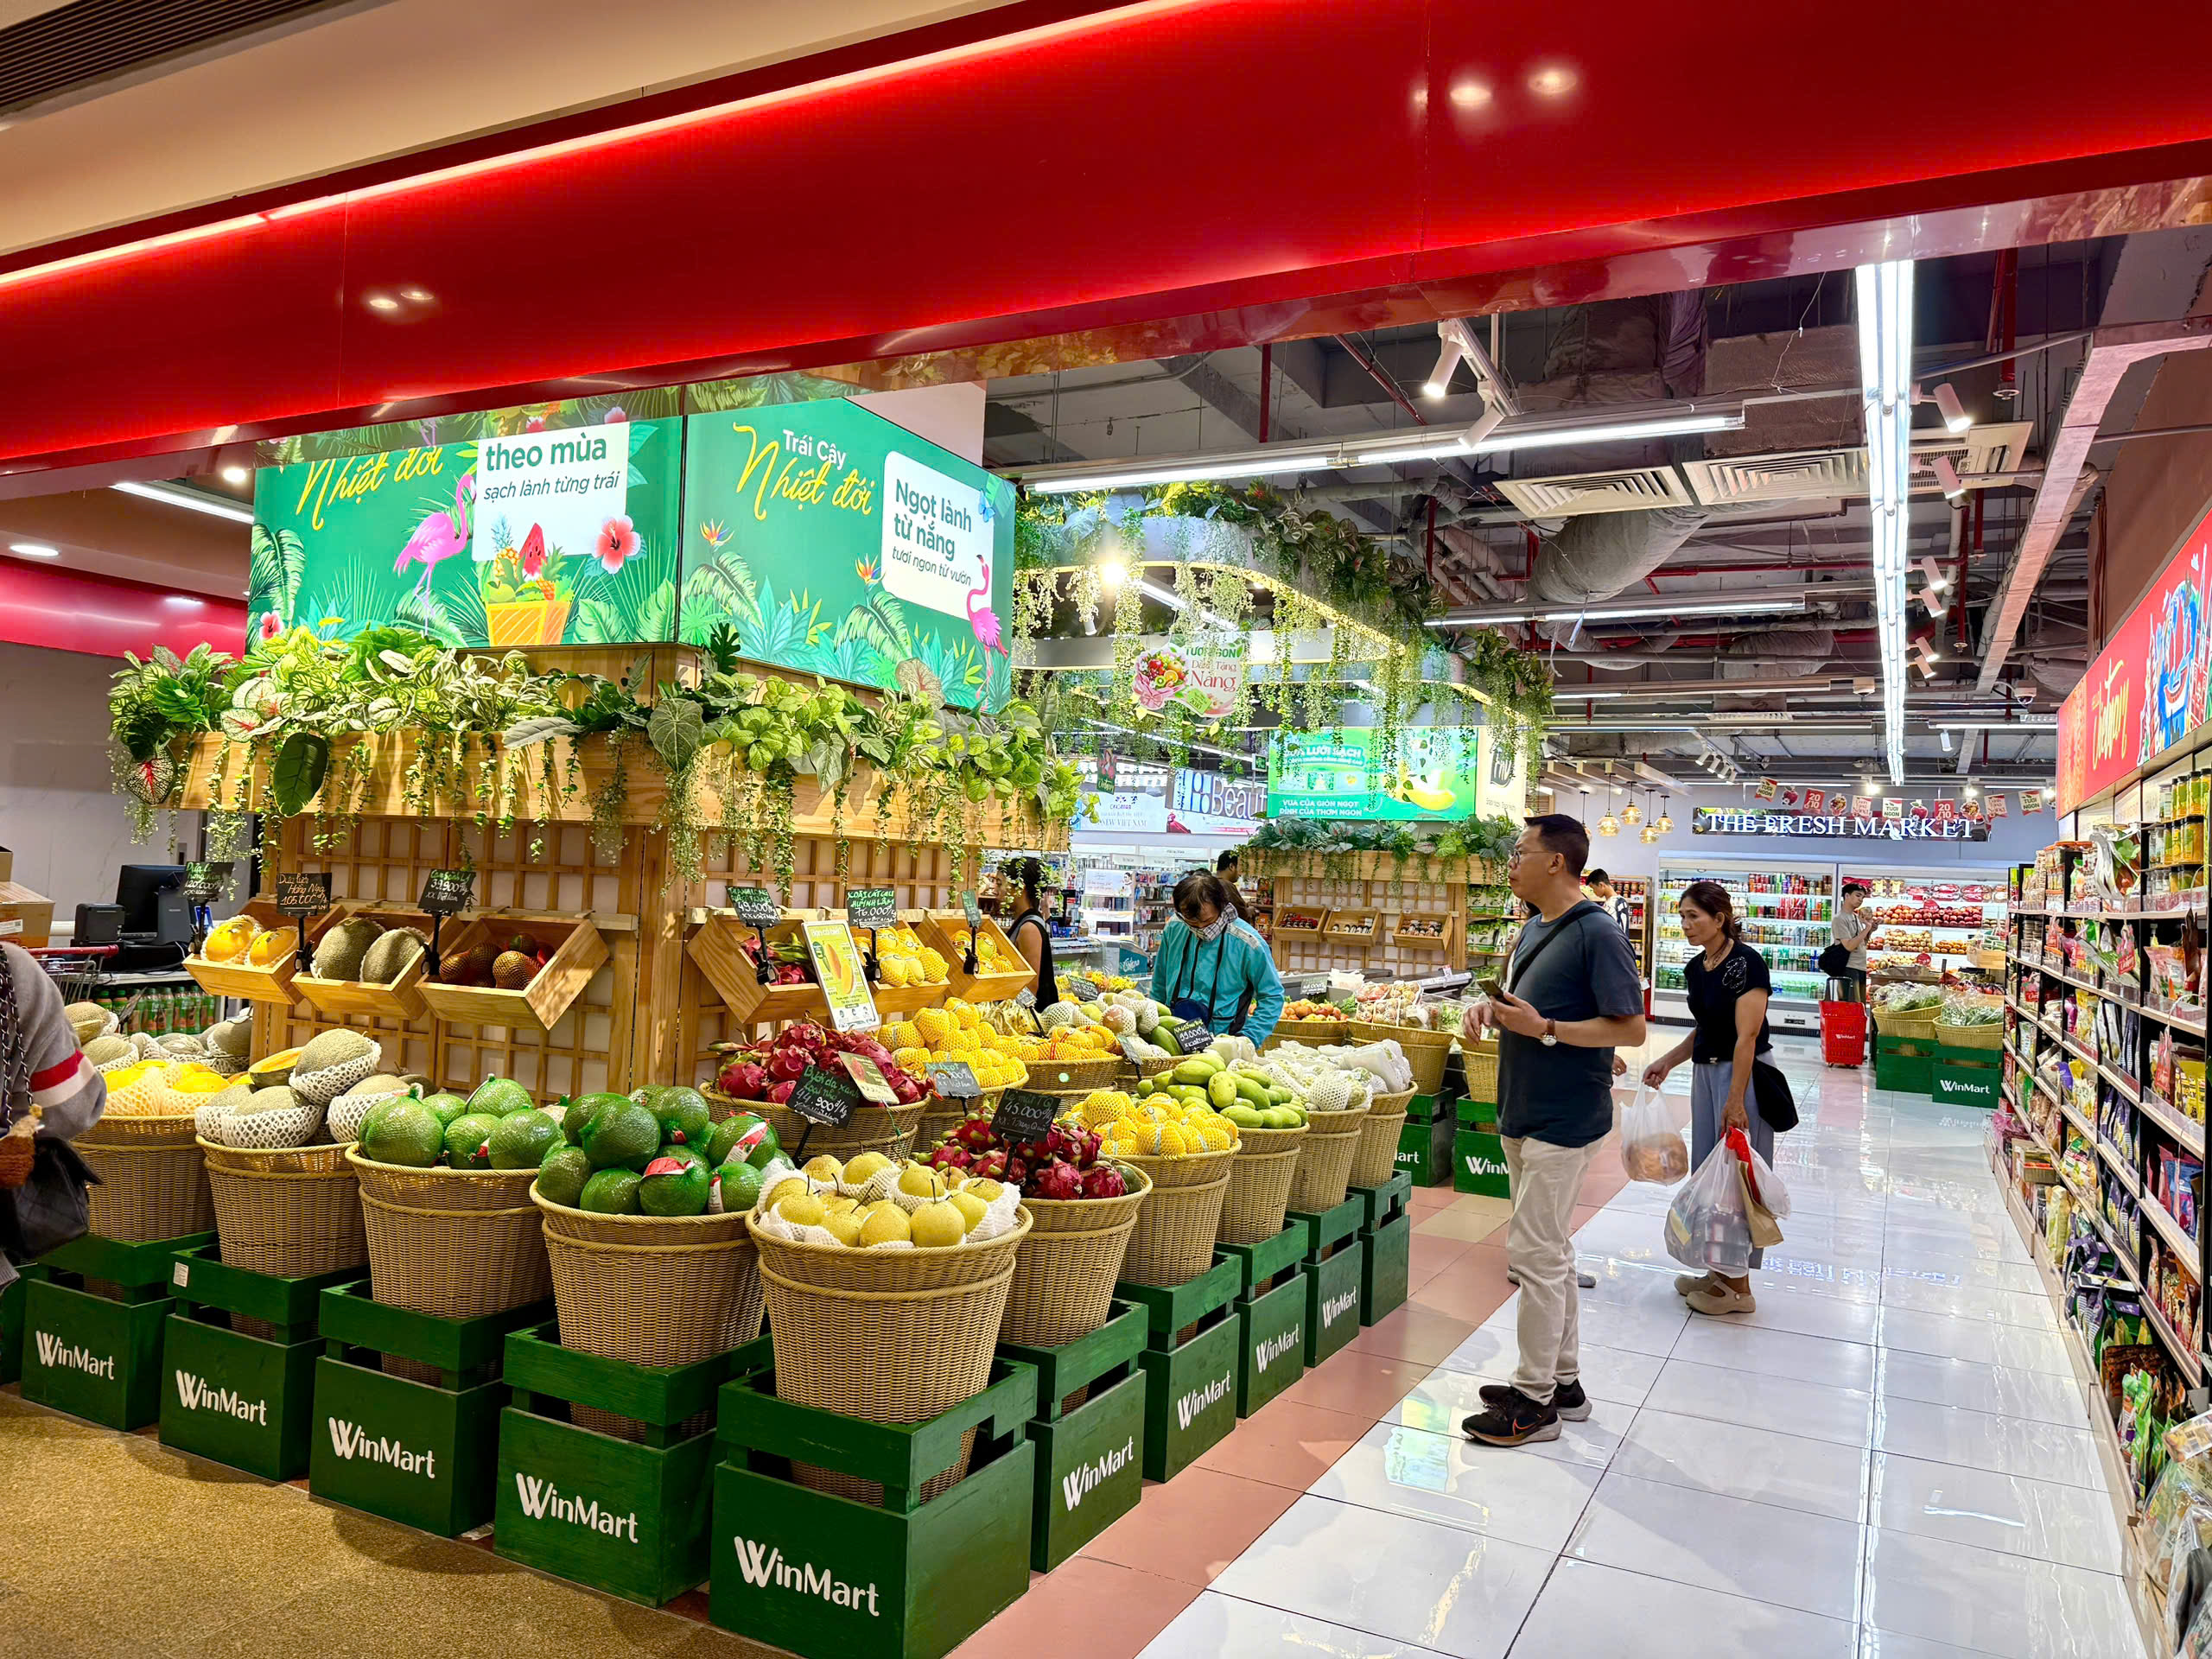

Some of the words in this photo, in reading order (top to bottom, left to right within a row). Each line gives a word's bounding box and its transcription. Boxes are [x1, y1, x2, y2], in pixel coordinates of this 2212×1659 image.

[485, 443, 543, 472] theo
[550, 432, 607, 464] mùa
[733, 422, 830, 520] Nhiệt
[832, 469, 876, 516] đới
[783, 429, 812, 458] Trái
[817, 441, 846, 470] Cây
[483, 479, 517, 503] sạch
[519, 477, 551, 498] lành
[554, 475, 589, 497] từng
[594, 470, 620, 491] trái
[896, 479, 937, 520] Ngọt
[941, 497, 972, 533] lành
[892, 545, 910, 565] tươi
[912, 556, 937, 576] ngon
[938, 562, 950, 579] từ
[894, 515, 911, 541] từ
[917, 521, 955, 562] nắng
[1808, 792, 1821, 802] 20
[1938, 803, 1950, 811] 20
[1705, 814, 1757, 834] THE
[1763, 815, 1847, 836] FRESH
[1853, 817, 1977, 839] MARKET
[1940, 1079, 1990, 1094] WinMart
[1322, 1285, 1357, 1329] WinMart
[35, 1330, 114, 1381] WinMart
[1255, 1323, 1300, 1374] WinMart
[176, 1370, 267, 1427] WinMart
[1177, 1370, 1231, 1431] WinMart
[328, 1416, 435, 1479] WinMart
[1063, 1435, 1135, 1511] WinMart
[516, 1471, 639, 1545] WinMart
[734, 1535, 880, 1618] WinMart
